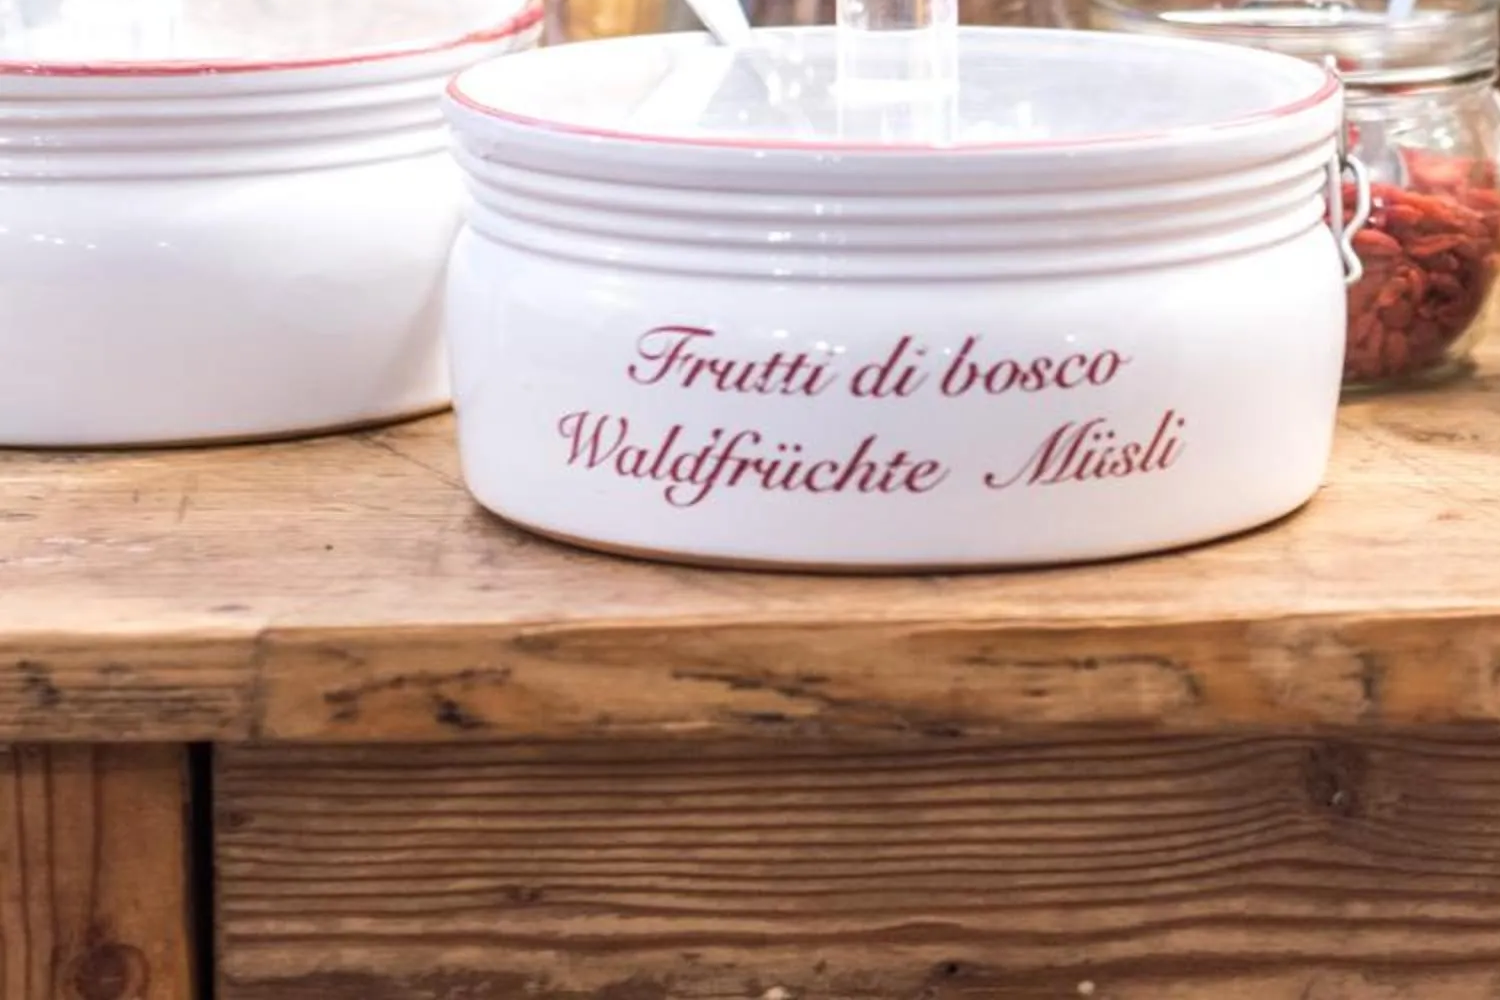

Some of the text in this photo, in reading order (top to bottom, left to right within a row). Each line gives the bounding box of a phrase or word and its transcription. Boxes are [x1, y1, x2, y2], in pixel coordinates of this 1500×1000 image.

[627, 325, 1132, 398] Frutti di bosco
[557, 409, 1186, 507] Waldfrüchte Müsli
